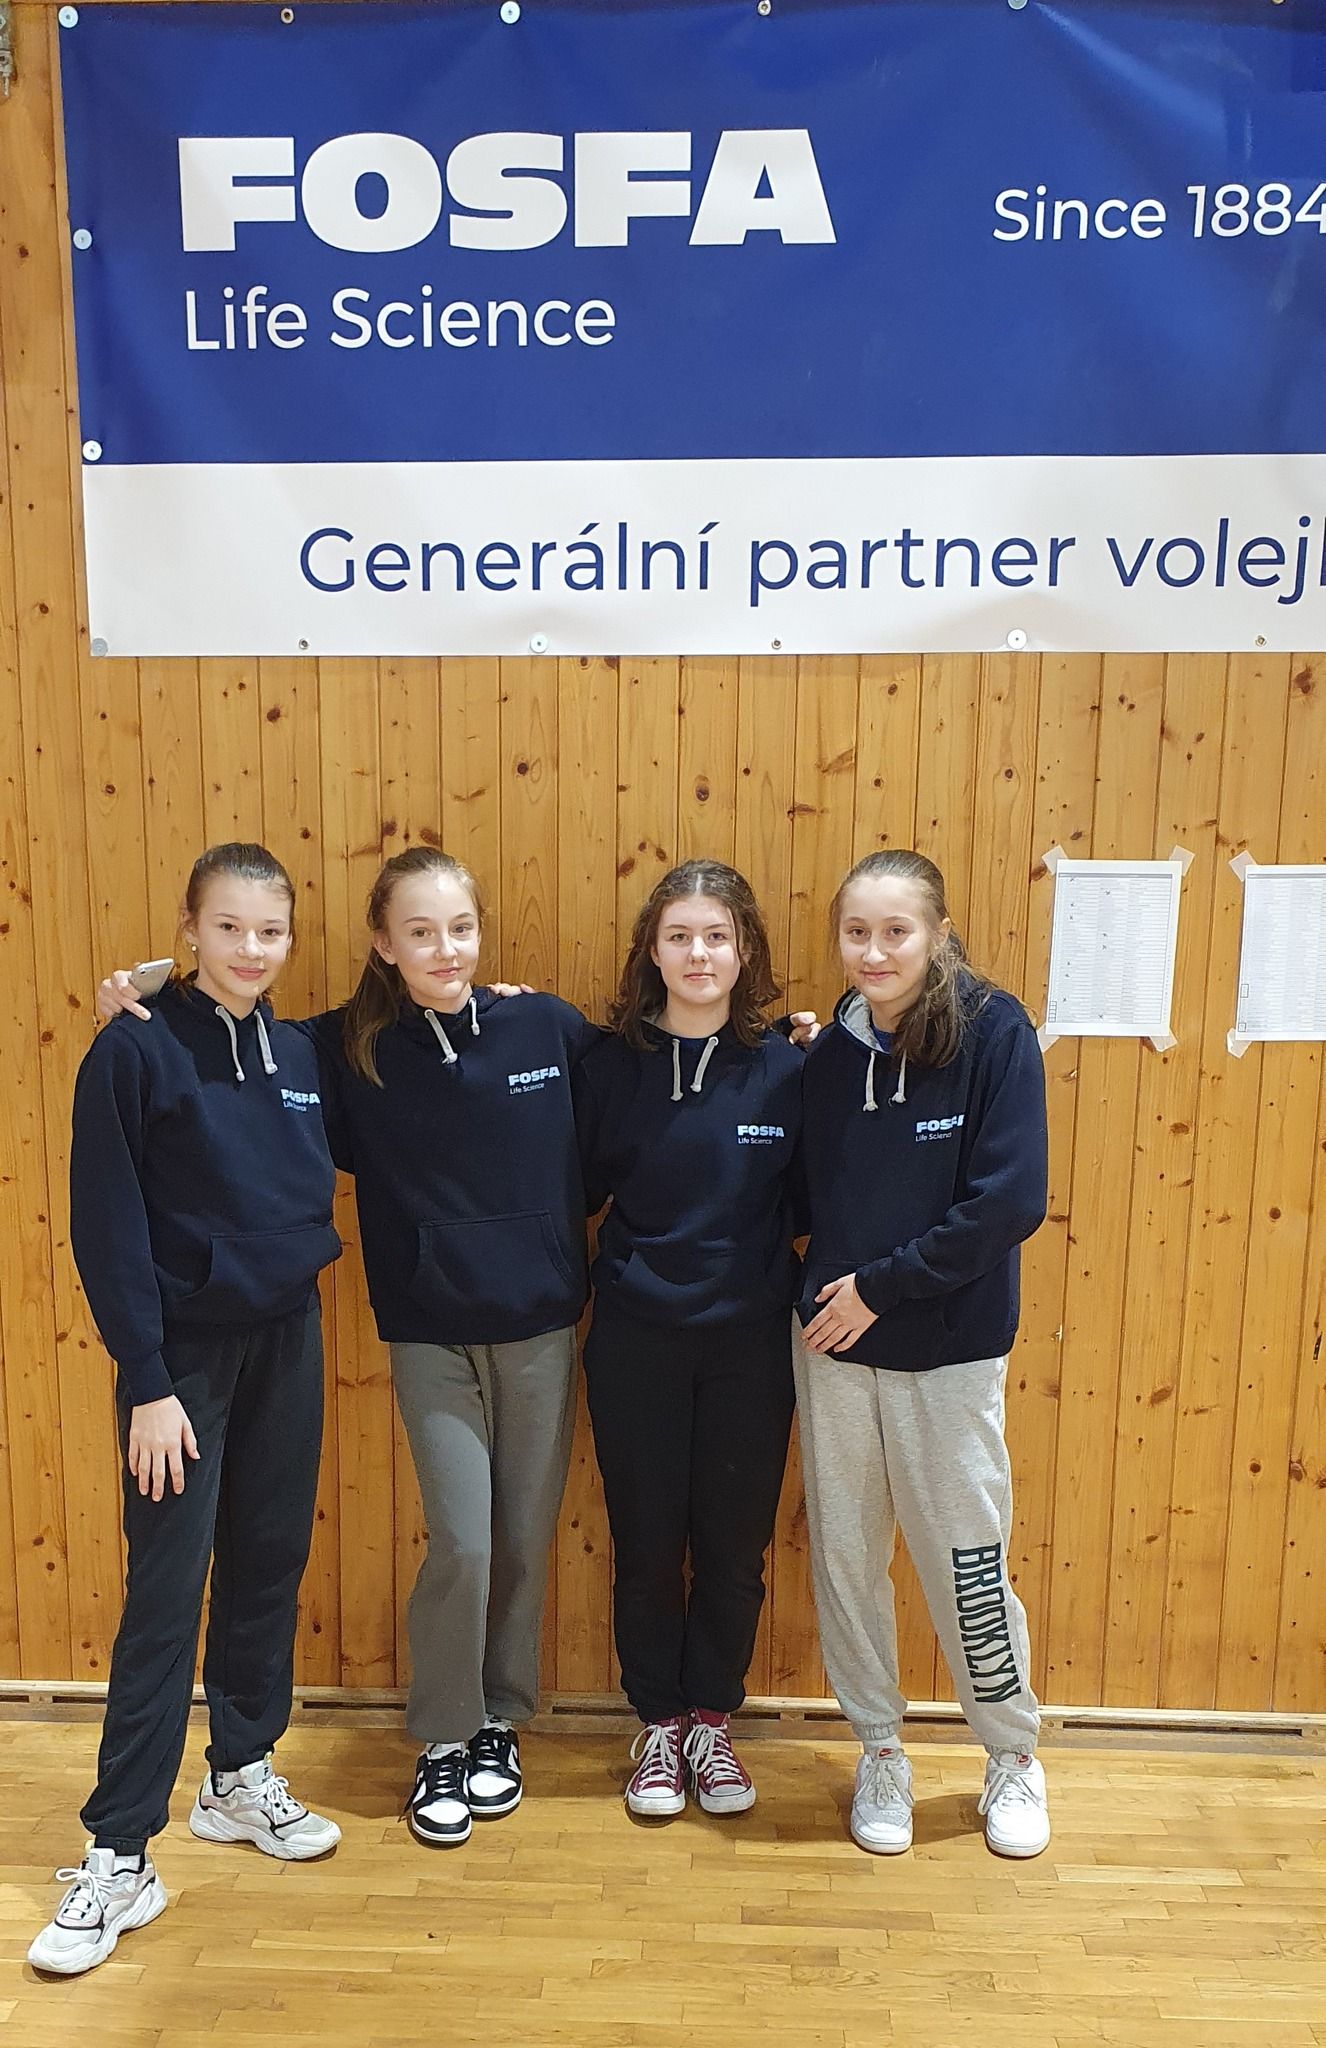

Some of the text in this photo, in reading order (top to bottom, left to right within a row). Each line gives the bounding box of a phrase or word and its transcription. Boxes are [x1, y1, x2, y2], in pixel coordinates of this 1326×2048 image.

[178, 128, 838, 254] FOSFA
[993, 182, 1326, 242] Since 1884
[185, 284, 617, 351] Life Science
[300, 514, 1326, 609] Generální partner volej
[508, 1066, 561, 1086] FOSFA
[509, 1087, 522, 1095] Life
[737, 1124, 785, 1138] FOSFA
[951, 1542, 1022, 1703] BROOKLYN
